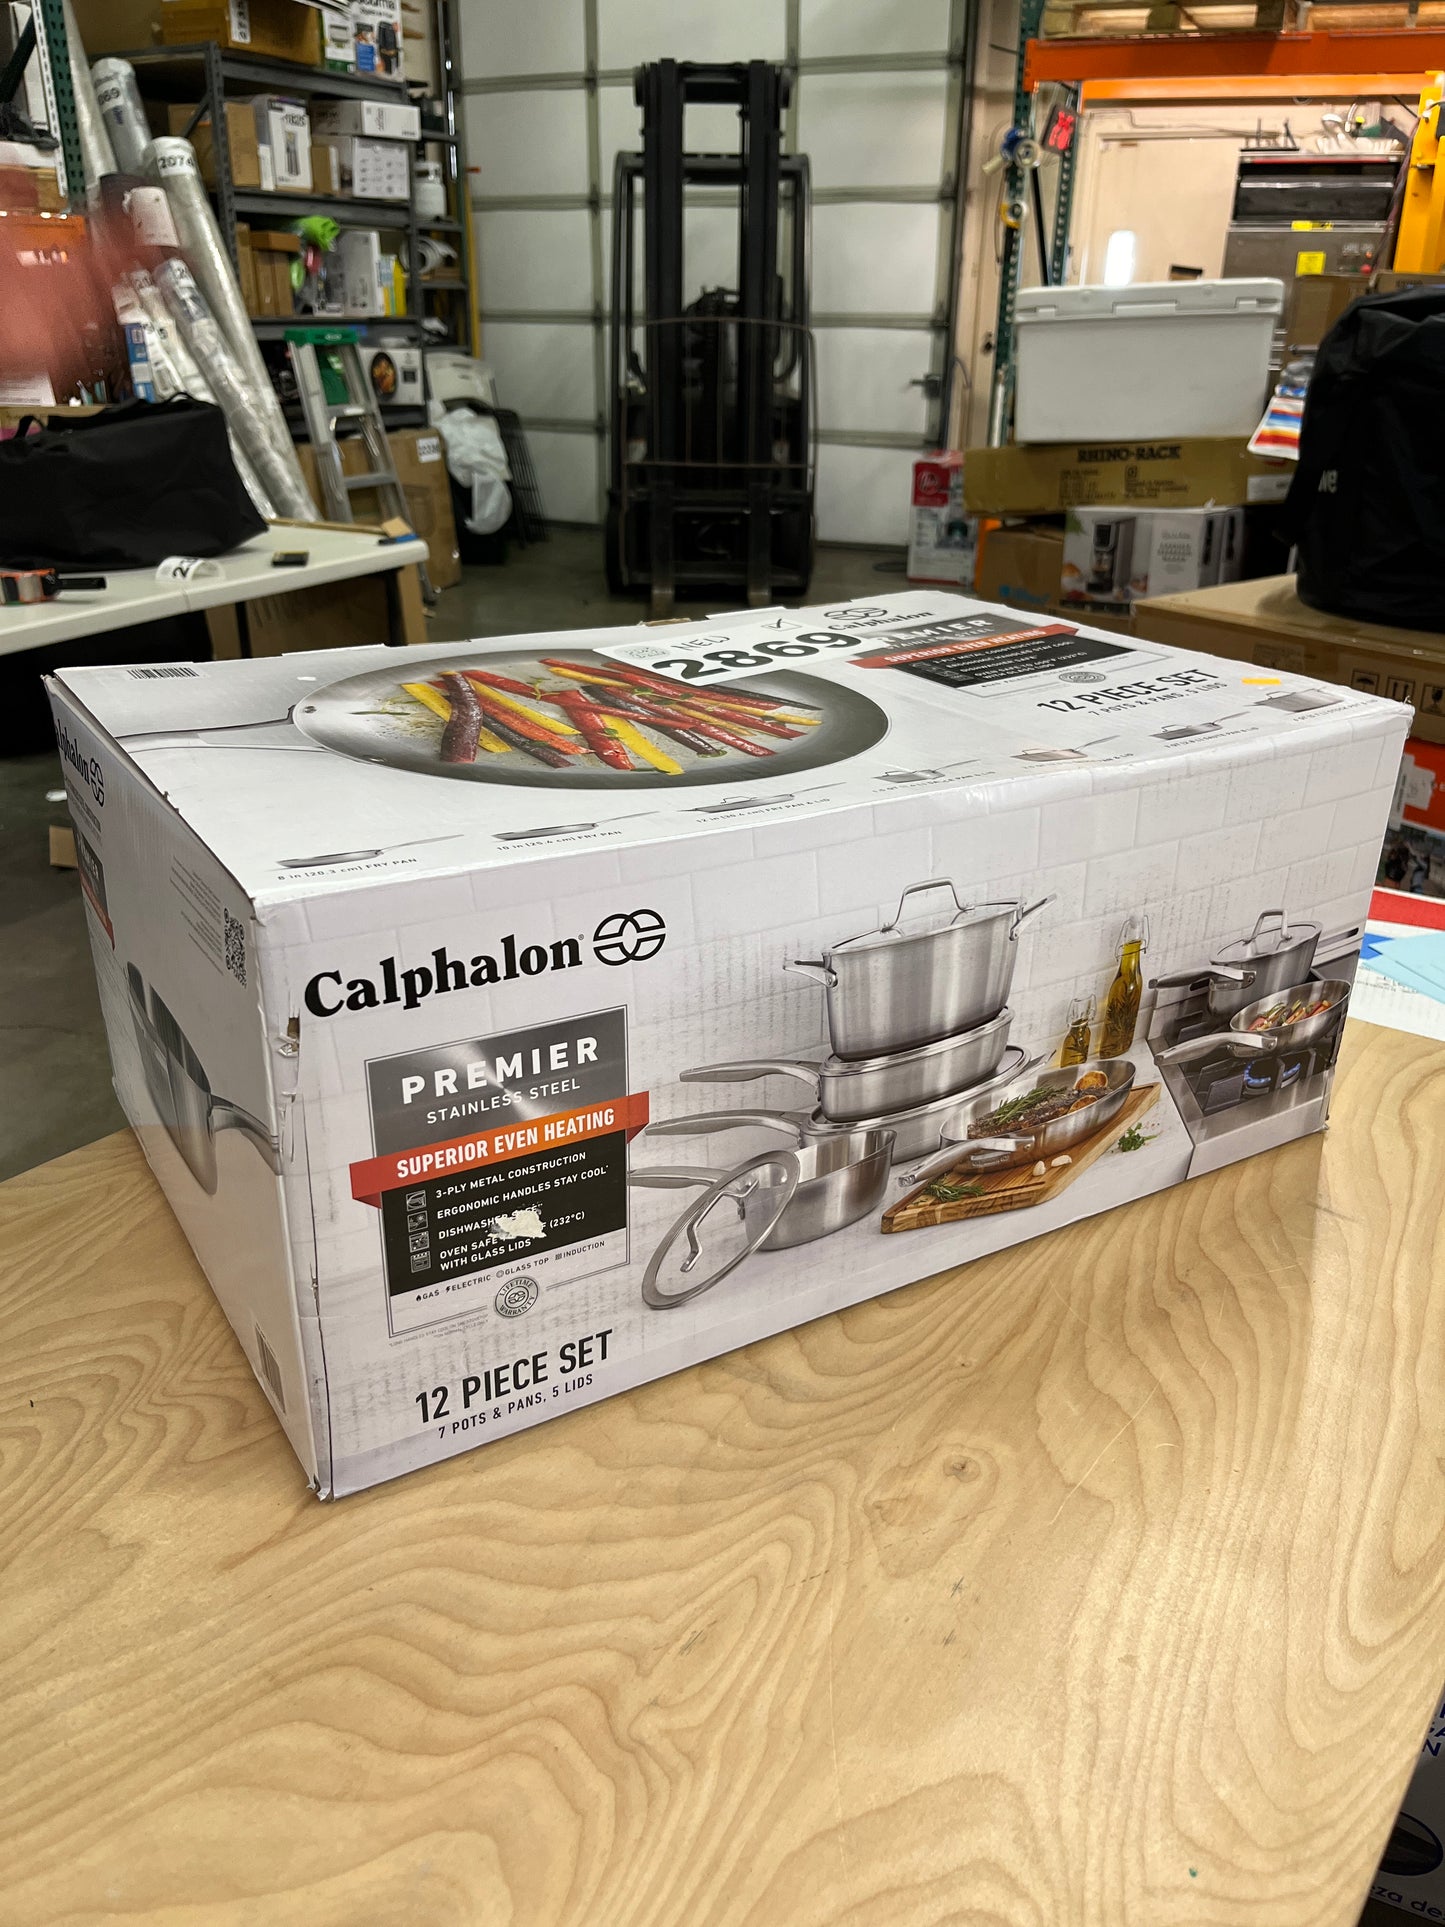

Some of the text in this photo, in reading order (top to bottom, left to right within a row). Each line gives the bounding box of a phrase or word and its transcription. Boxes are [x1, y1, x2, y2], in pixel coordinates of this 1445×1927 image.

[1077, 446, 1181, 463] RHINO-RACK
[828, 610, 934, 632] Calphalon
[651, 631, 862, 680] 2869
[1037, 668, 1219, 713] 12 PIECE SET
[365, 861, 389, 870] FRY
[391, 857, 419, 866] PAN
[304, 933, 583, 1018] Calphalon
[401, 1036, 599, 1105] PREMIER
[426, 1077, 581, 1124] STAINLESS STEEL
[397, 1107, 616, 1178] SUPERIOR EVEN HEATING
[436, 1151, 587, 1199] 3-PLY METAL CONSTRUCTION
[436, 1194, 500, 1220] ERGONOMIC
[502, 1180, 553, 1203] HANDLES
[553, 1173, 579, 1189] STAY
[439, 1210, 586, 1260] OVEN SAFE (232°C)
[440, 1238, 532, 1271] WITH GLASS LIDS
[422, 1240, 606, 1301] GAS ELECTRIC GLASS TOP INDUCTION
[500, 1277, 534, 1296] LIFETIME
[500, 1297, 535, 1316] WARRANTY
[415, 1328, 613, 1423] 12 PIECE SET
[437, 1373, 594, 1440] 7 POTS & PANS, 5 LIDS
